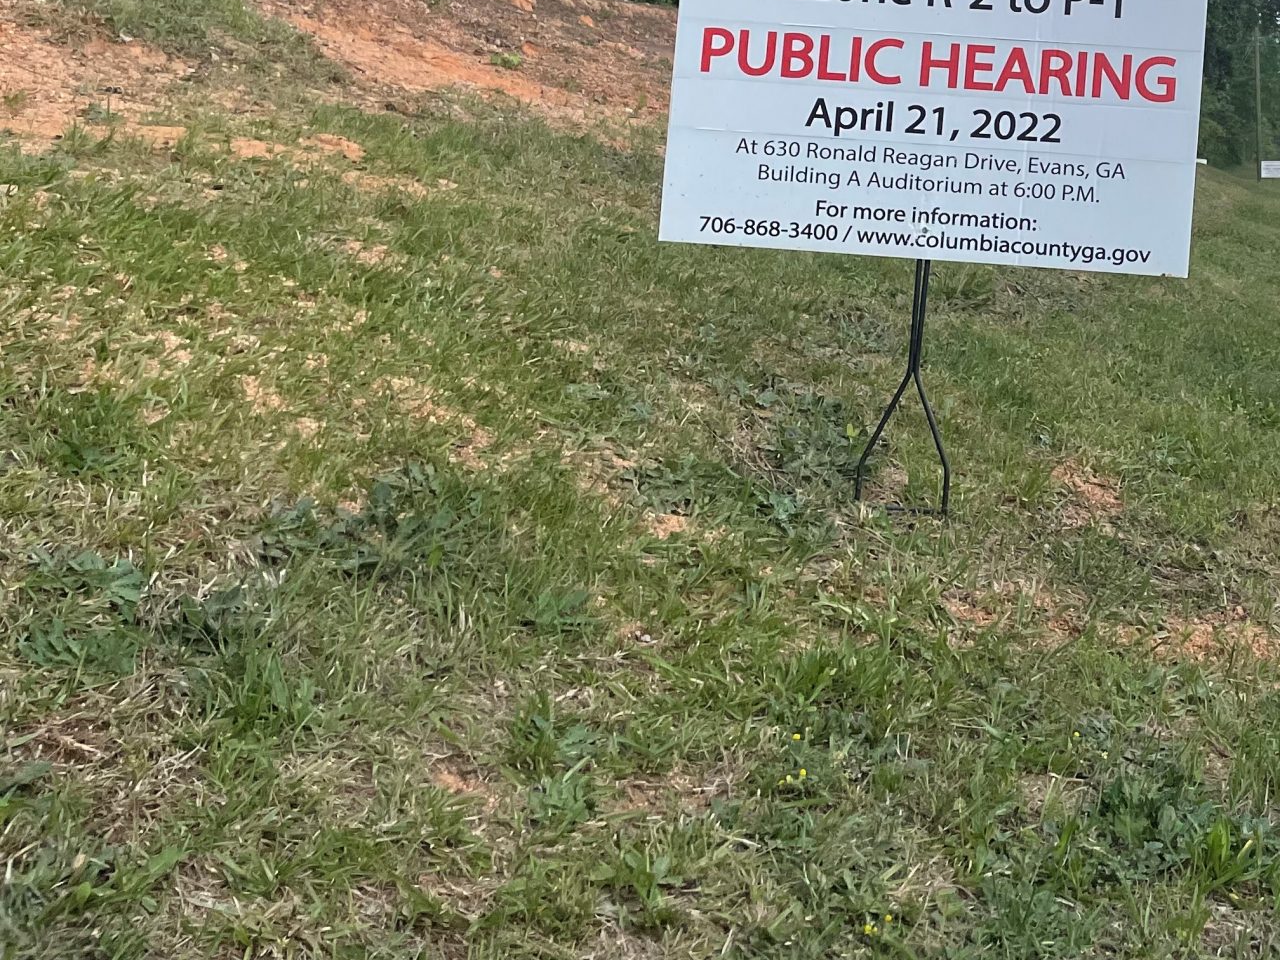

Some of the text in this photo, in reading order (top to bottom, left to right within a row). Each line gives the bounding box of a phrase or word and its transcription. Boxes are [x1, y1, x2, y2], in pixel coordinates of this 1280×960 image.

[700, 27, 1177, 103] PUBLIC HEARING
[804, 97, 1062, 144] April 21, 2022
[735, 137, 1126, 180] At 630 Ronald Reagan Drive, Evans, GA
[757, 163, 1100, 203] Building A Auditorium at 6:00 P.M.
[815, 199, 1037, 232] For more information:
[699, 215, 1151, 266] 706-868-3400 / www.columbiacountyga.gov
